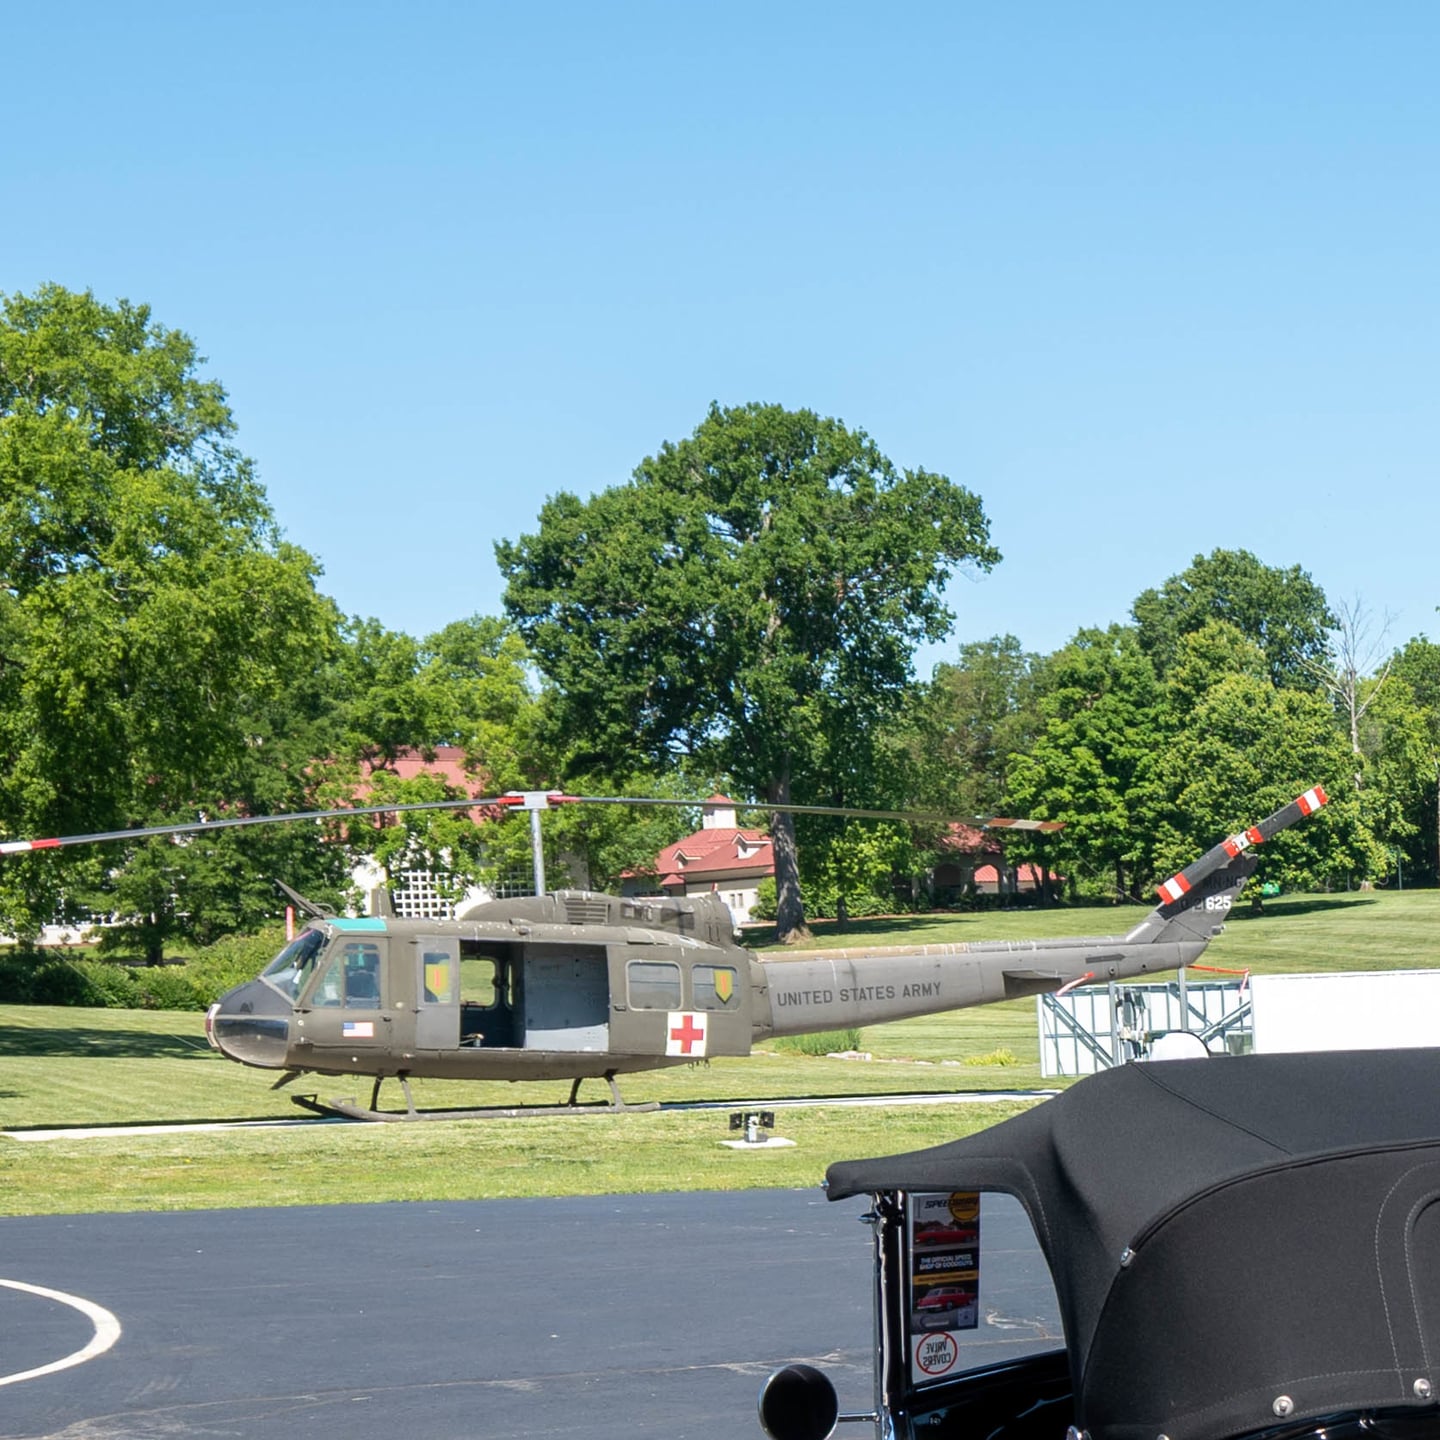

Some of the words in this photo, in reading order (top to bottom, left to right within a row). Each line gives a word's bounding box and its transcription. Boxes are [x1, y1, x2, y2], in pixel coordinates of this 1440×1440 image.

[777, 990, 833, 1007] UNITED
[839, 985, 895, 1002] STATES
[902, 982, 941, 998] ARMY
